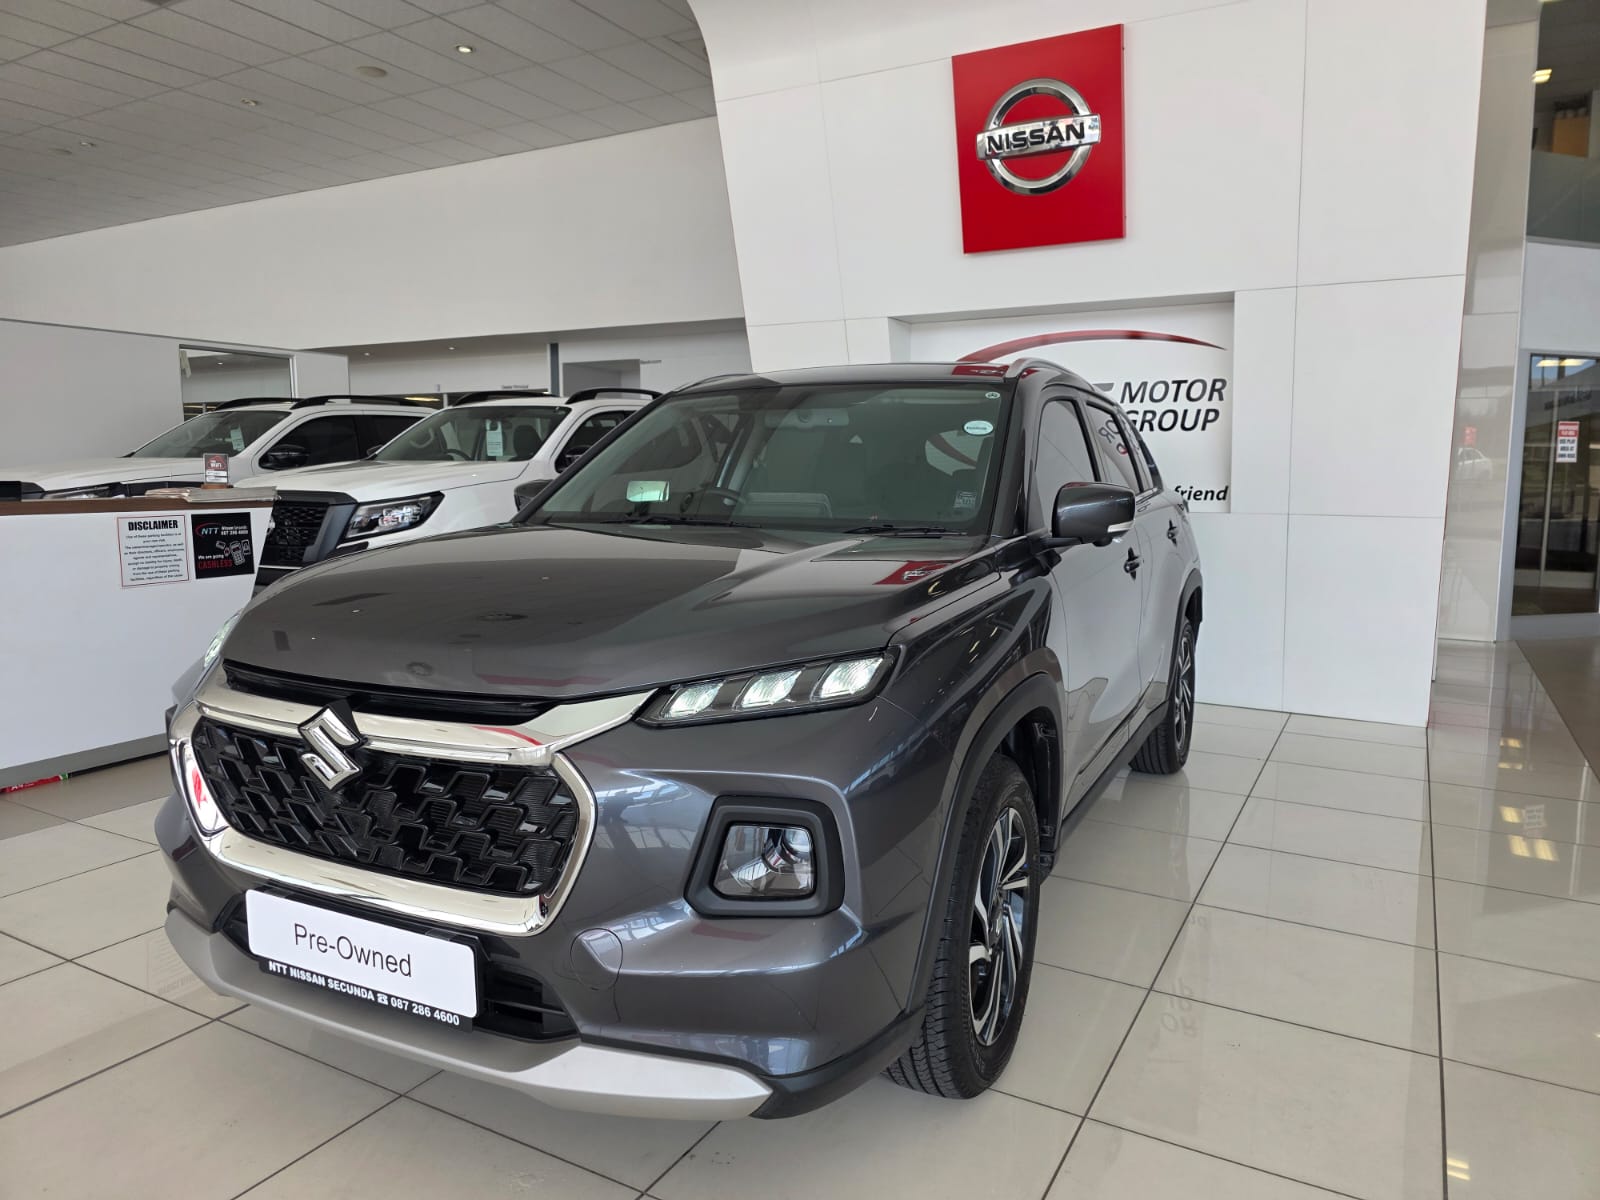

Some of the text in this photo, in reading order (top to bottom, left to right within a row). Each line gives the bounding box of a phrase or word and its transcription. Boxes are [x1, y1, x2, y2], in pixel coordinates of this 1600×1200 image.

[987, 123, 1085, 153] NISSAN
[1120, 378, 1227, 403] MOTOR
[128, 520, 178, 531] DISCLAIMER
[201, 527, 219, 535] NTT
[294, 923, 412, 977] Pre-Owned
[268, 960, 460, 1026] NTT NISSAN SECUNDA 087 286 4600
